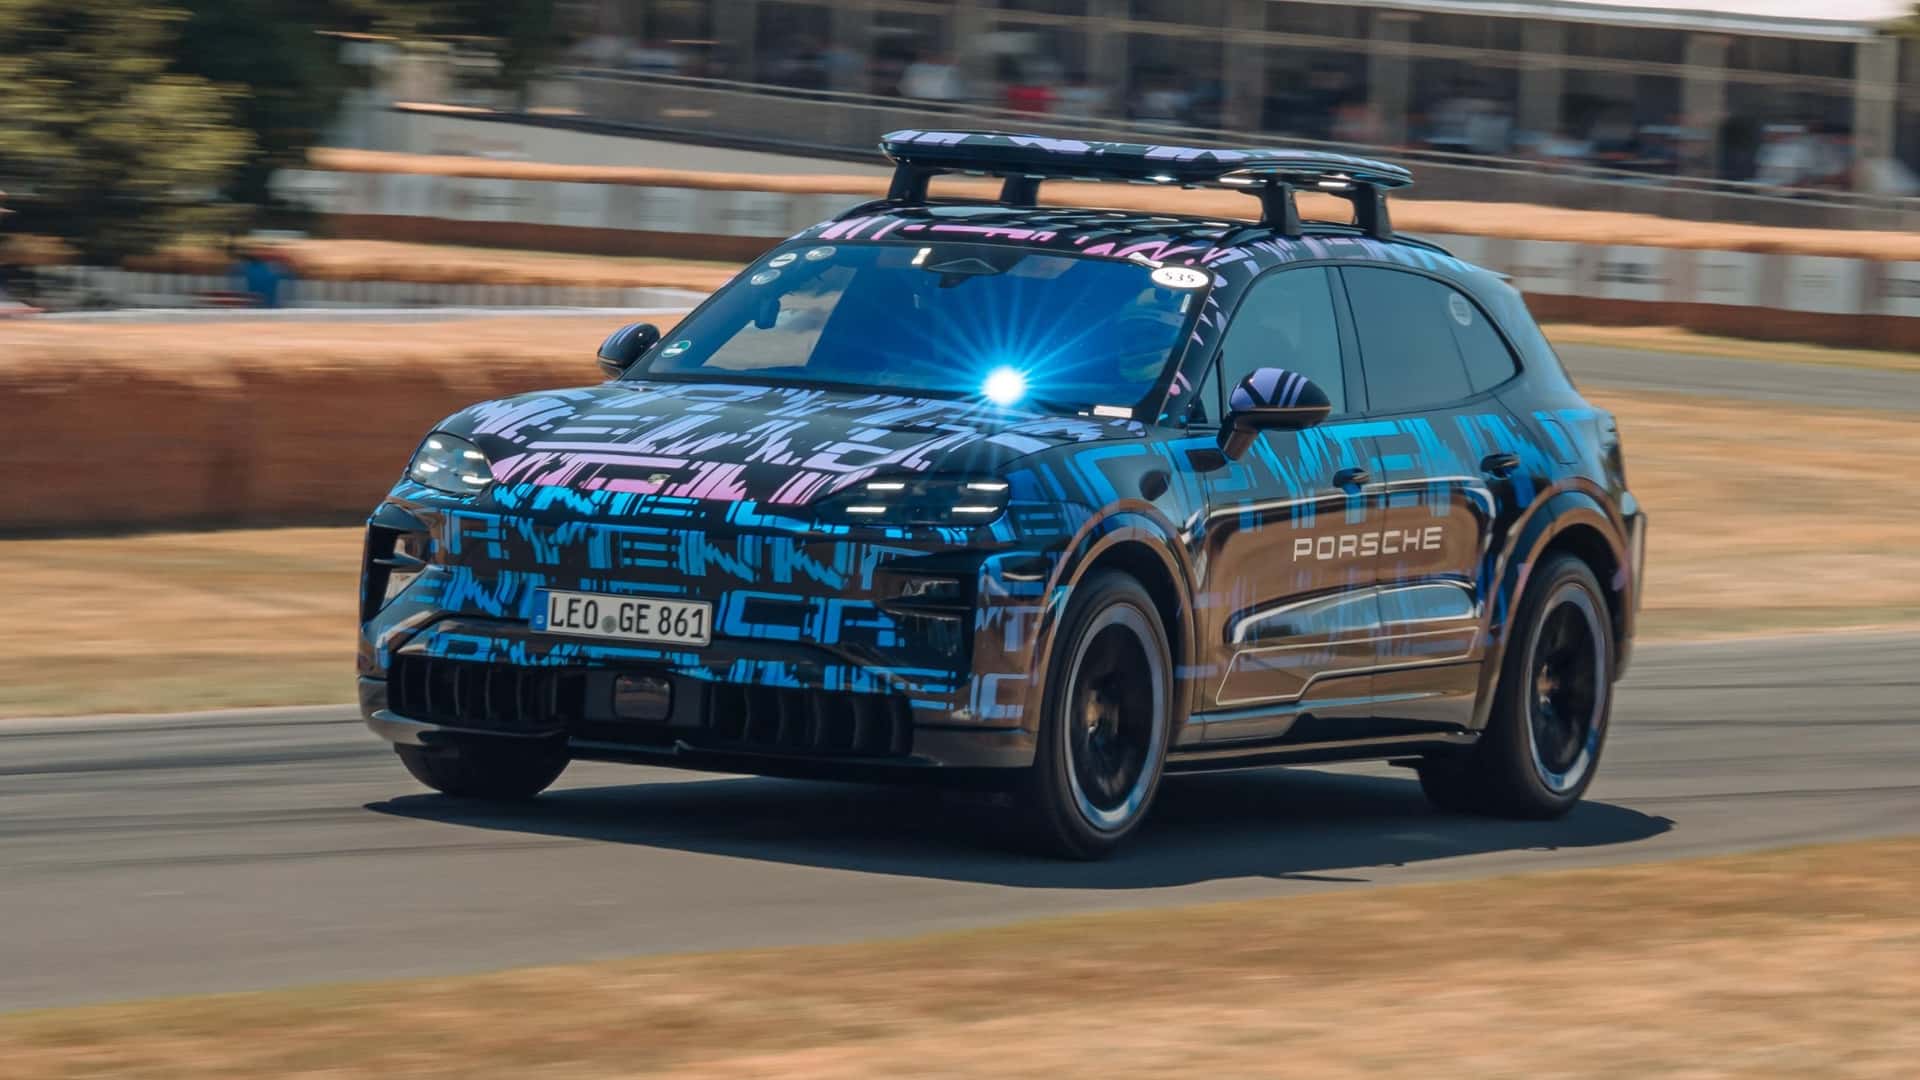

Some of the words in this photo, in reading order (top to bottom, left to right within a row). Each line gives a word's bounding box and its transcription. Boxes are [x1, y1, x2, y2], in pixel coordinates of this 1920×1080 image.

[1164, 271, 1196, 283] 535
[1293, 526, 1442, 562] PORSCHE
[550, 597, 599, 630] LEO
[619, 602, 652, 634] GE
[657, 606, 704, 638] 861
